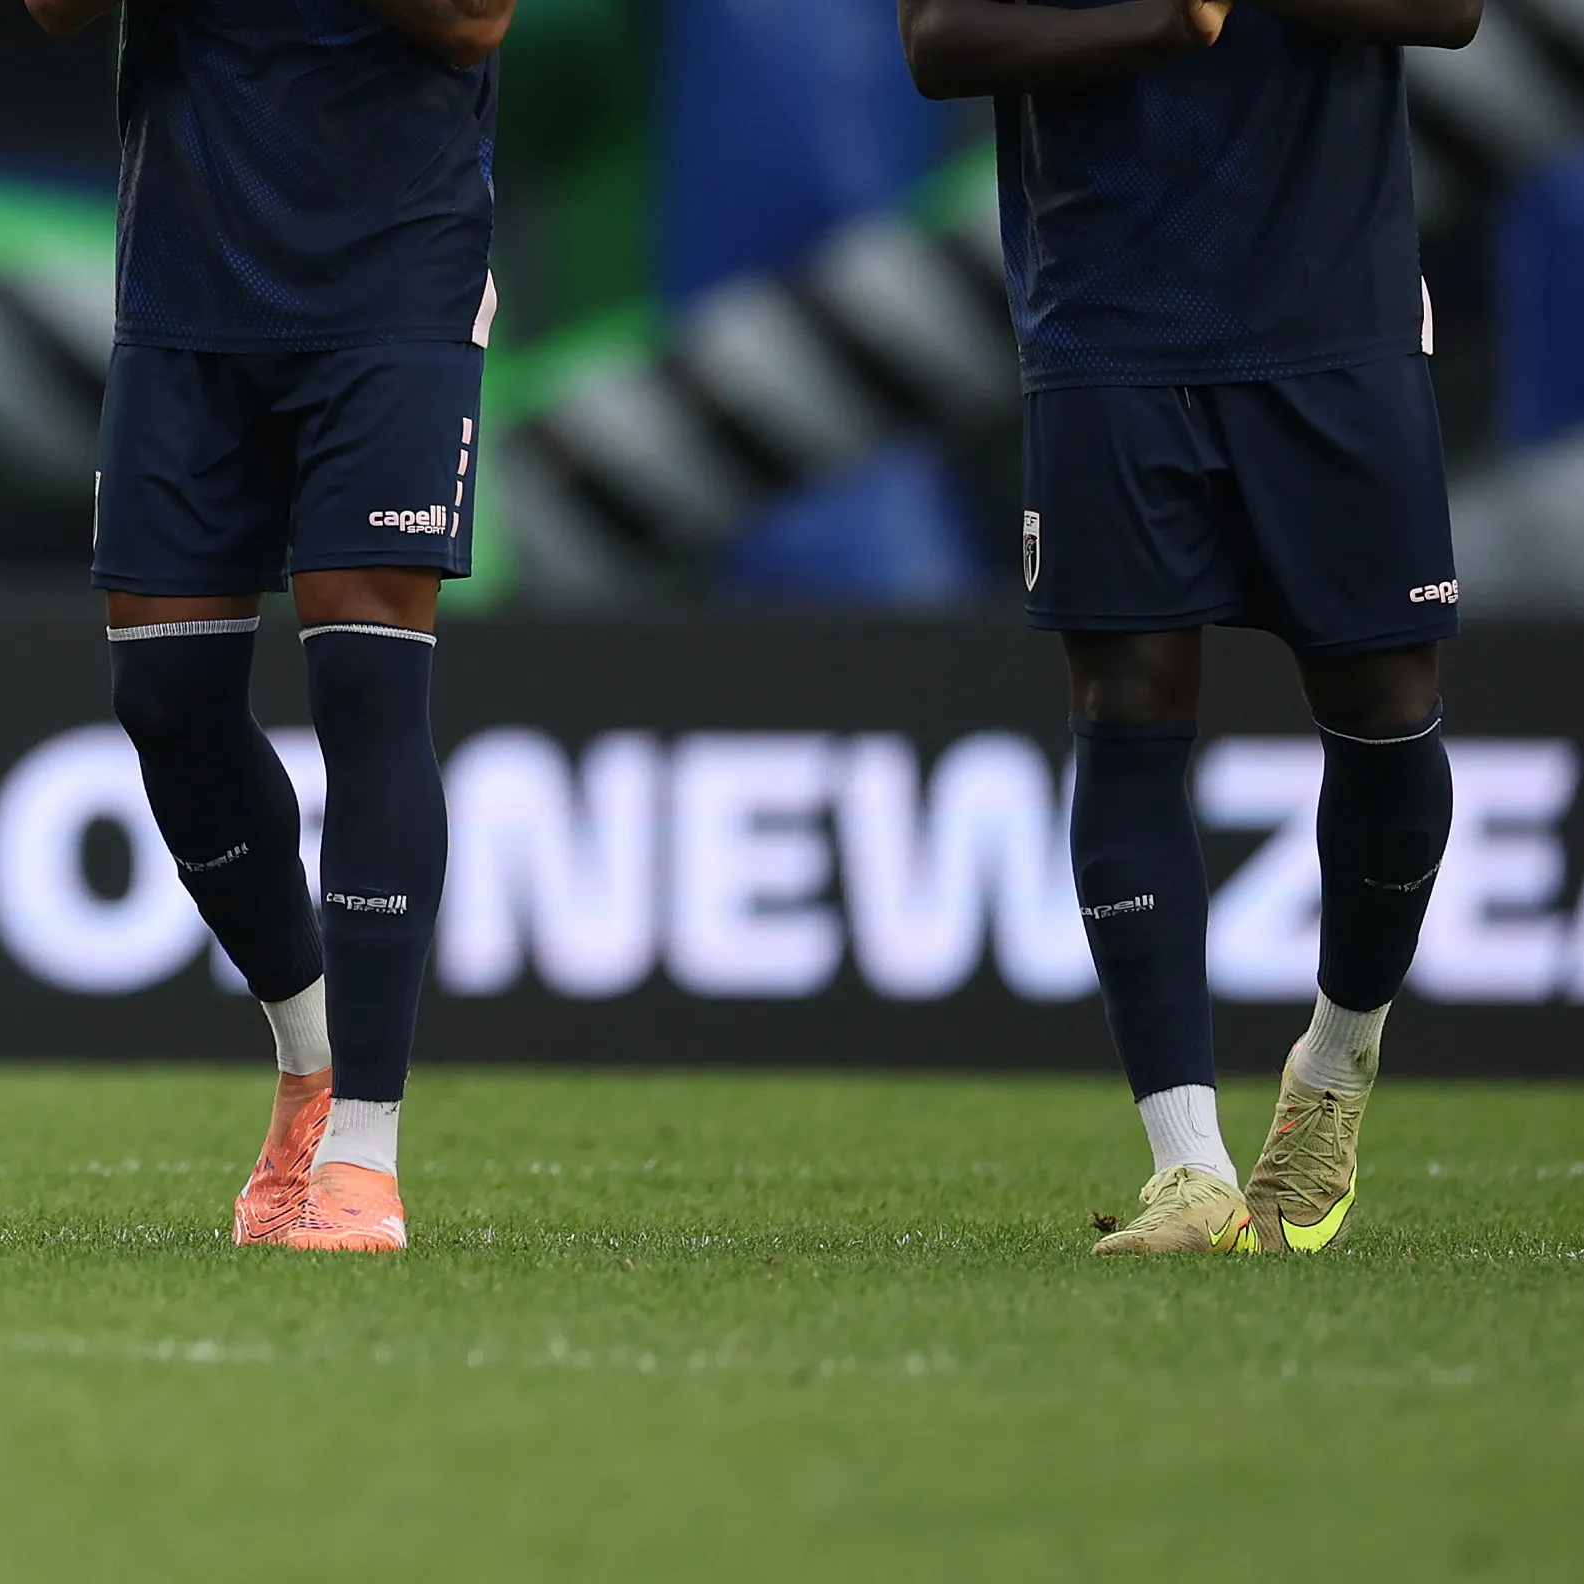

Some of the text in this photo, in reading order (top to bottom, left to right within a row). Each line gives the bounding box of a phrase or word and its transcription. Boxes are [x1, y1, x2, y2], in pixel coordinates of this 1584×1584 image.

[368, 504, 447, 531] capelli
[406, 525, 446, 535] SPORT
[431, 724, 1096, 1004] NEW
[326, 892, 408, 910] capelli
